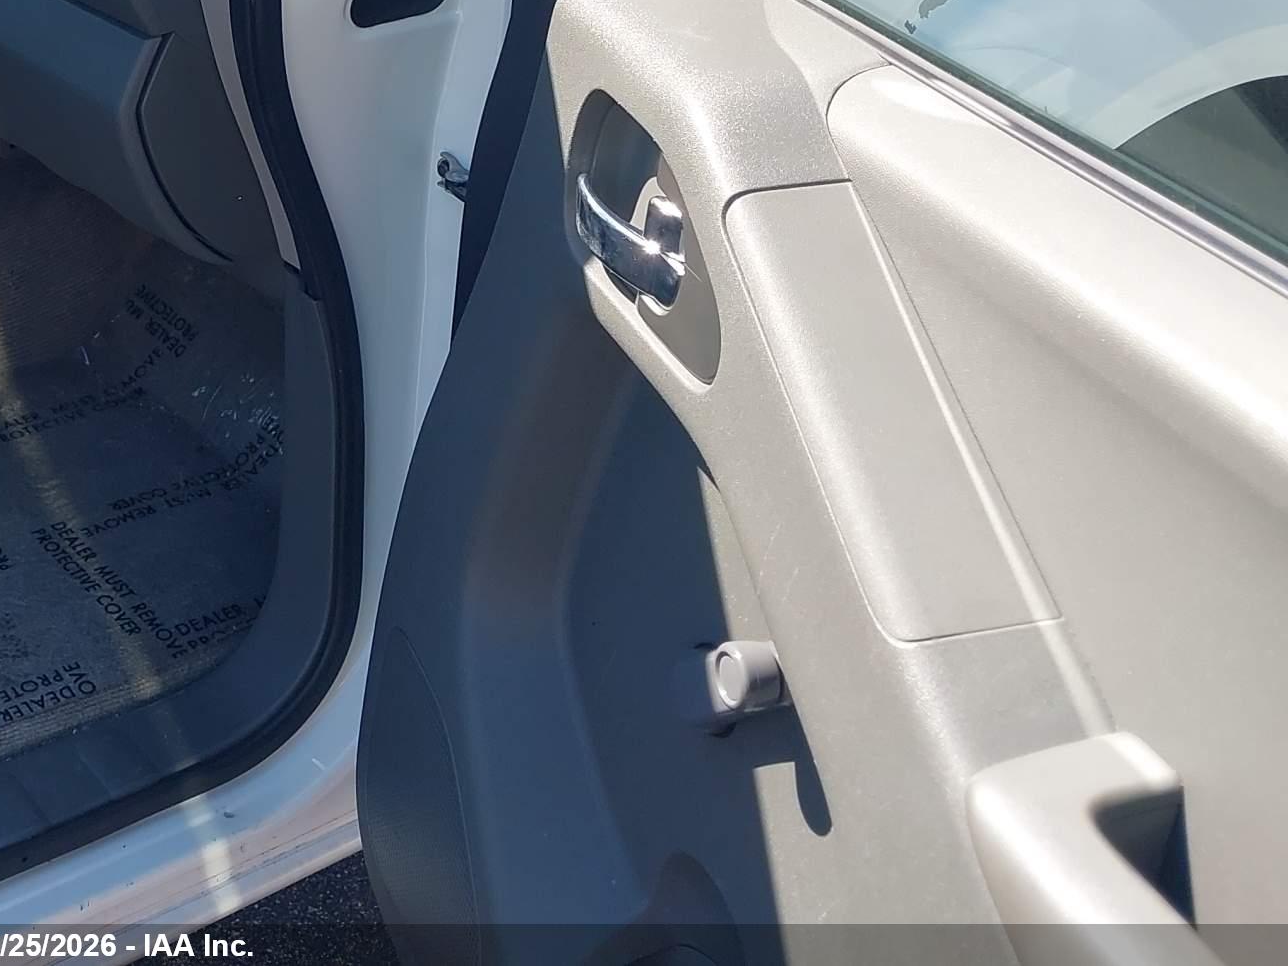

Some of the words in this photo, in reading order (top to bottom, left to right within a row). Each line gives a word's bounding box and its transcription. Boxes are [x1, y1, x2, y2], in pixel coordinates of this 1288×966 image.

[79, 503, 156, 538] REMOVE
[30, 528, 103, 598] PROTECTIVE
[96, 592, 142, 637] COVER
[50, 520, 98, 565] DEALER
[94, 562, 137, 603] MUST
[130, 598, 189, 661] REMOVE
[173, 602, 247, 637] DEALER
